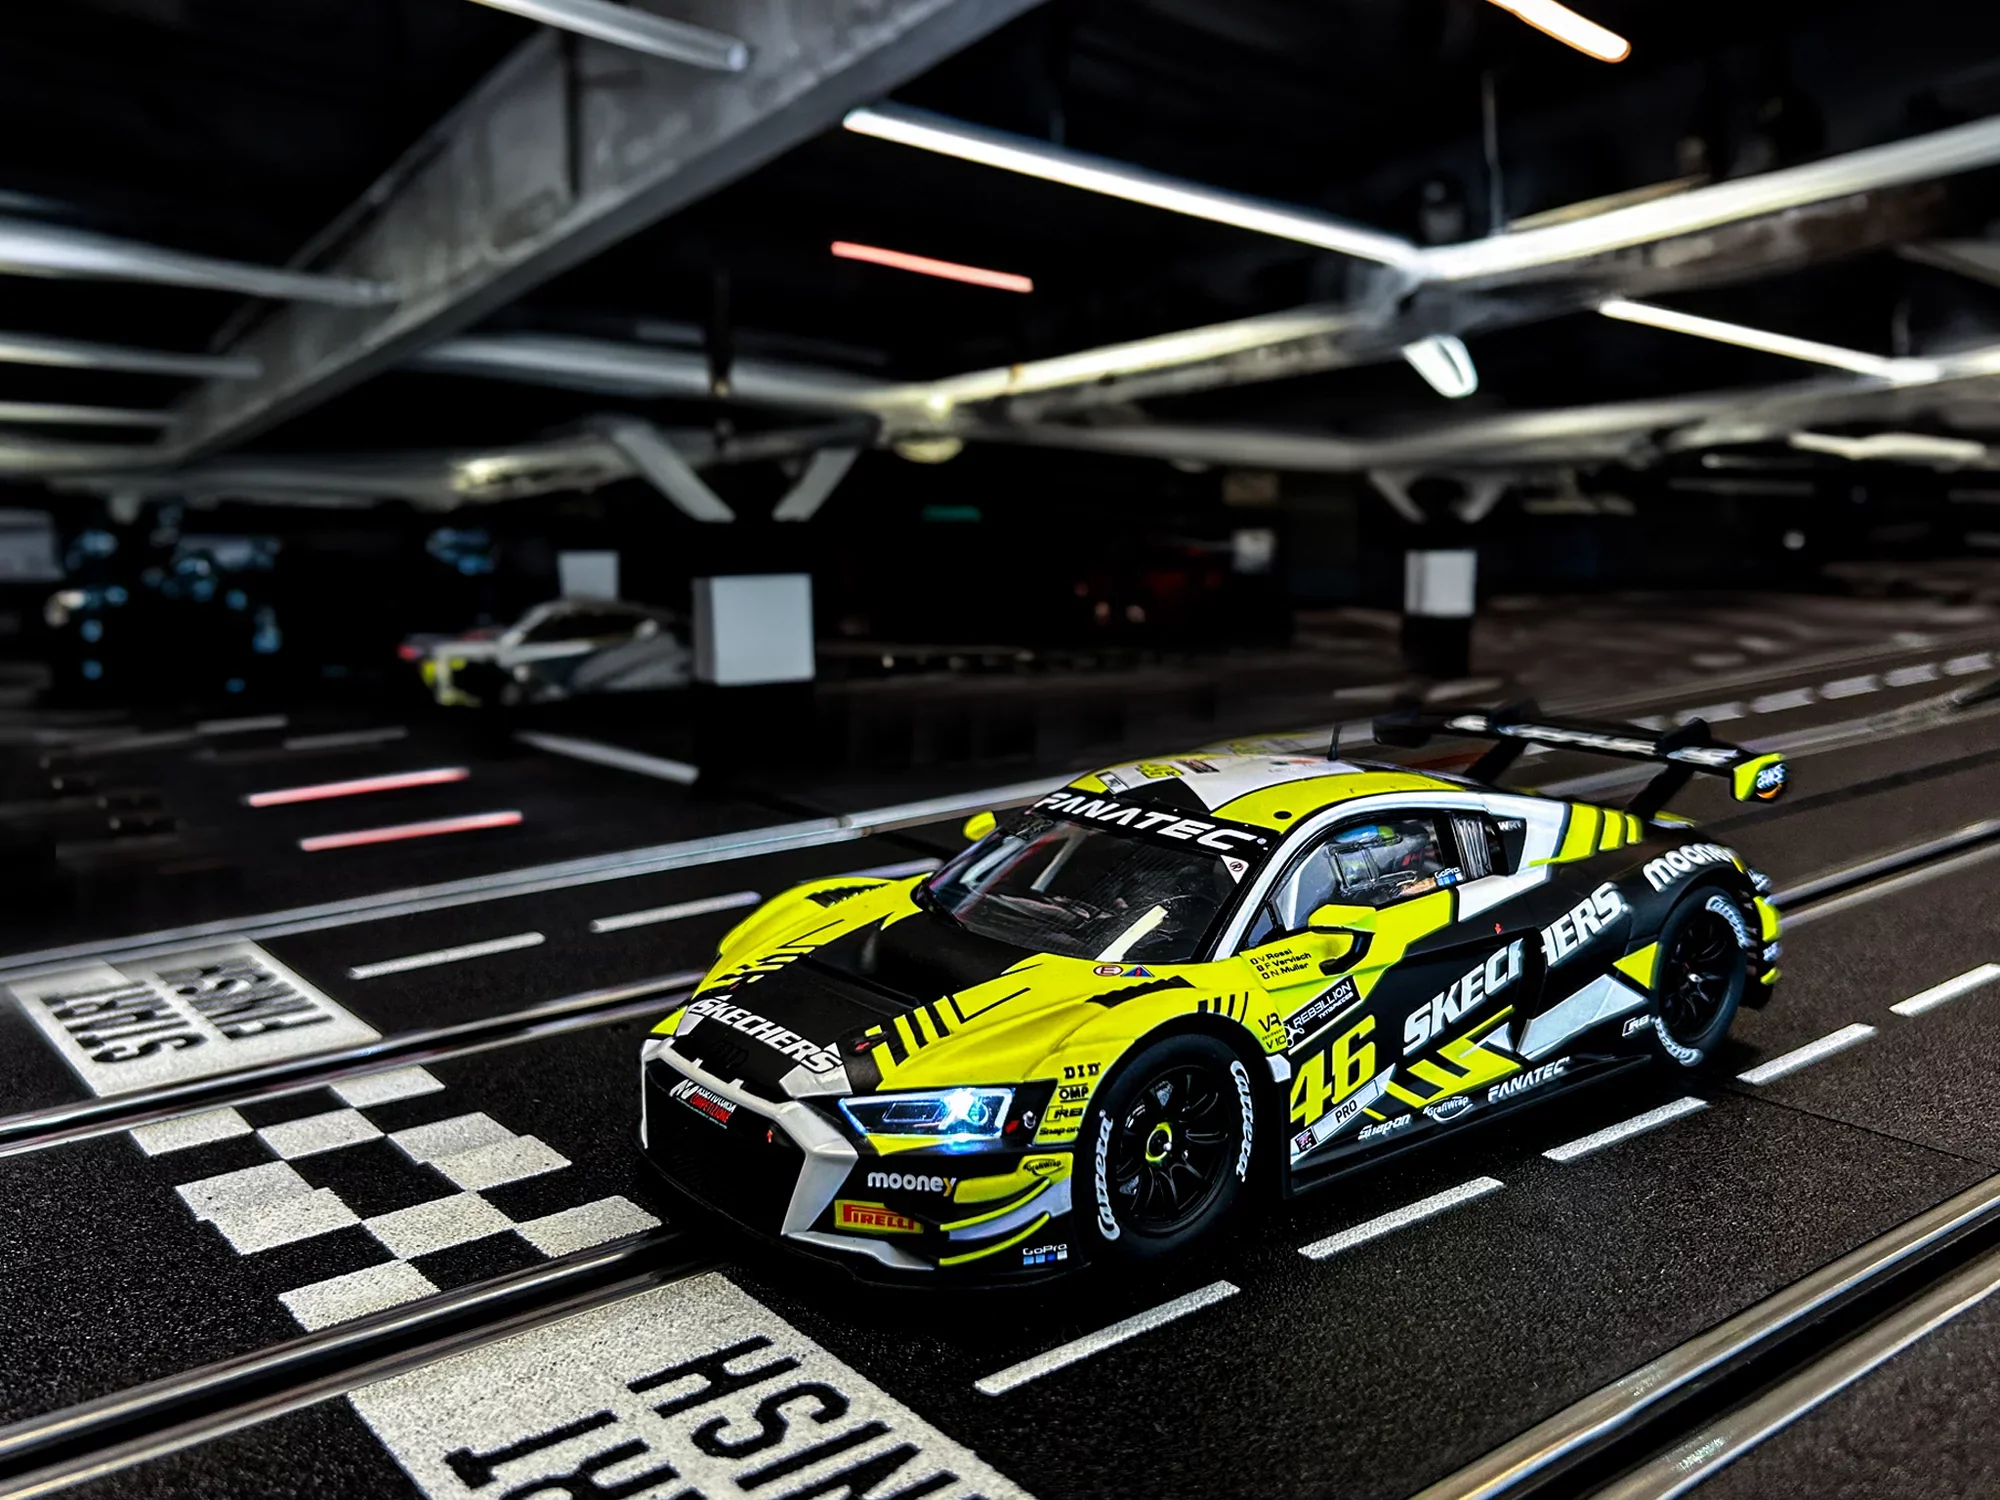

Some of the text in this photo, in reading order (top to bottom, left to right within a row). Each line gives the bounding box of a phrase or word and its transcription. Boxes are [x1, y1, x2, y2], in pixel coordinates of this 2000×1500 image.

[1033, 793, 1258, 850] FANATEC
[1435, 867, 1460, 879] GoPro
[1266, 949, 1293, 960] Rossi
[1280, 963, 1309, 974] Muller
[157, 955, 334, 1040] FINISH
[38, 981, 207, 1063] START
[1258, 1012, 1282, 1032] VR
[688, 999, 844, 1073] SKECHERS
[1290, 1014, 1376, 1127] 46
[1487, 1056, 1568, 1103] FANATEC
[1059, 1086, 1089, 1100] OMP
[1230, 1060, 1253, 1177] Carrera
[1335, 1100, 1358, 1123] PRO
[1358, 1113, 1411, 1140] Snap-on
[867, 1172, 957, 1197] mooney
[1095, 1116, 1120, 1241] Carrera
[843, 1204, 915, 1230] PIRELLI
[1022, 1243, 1068, 1255] GoPro
